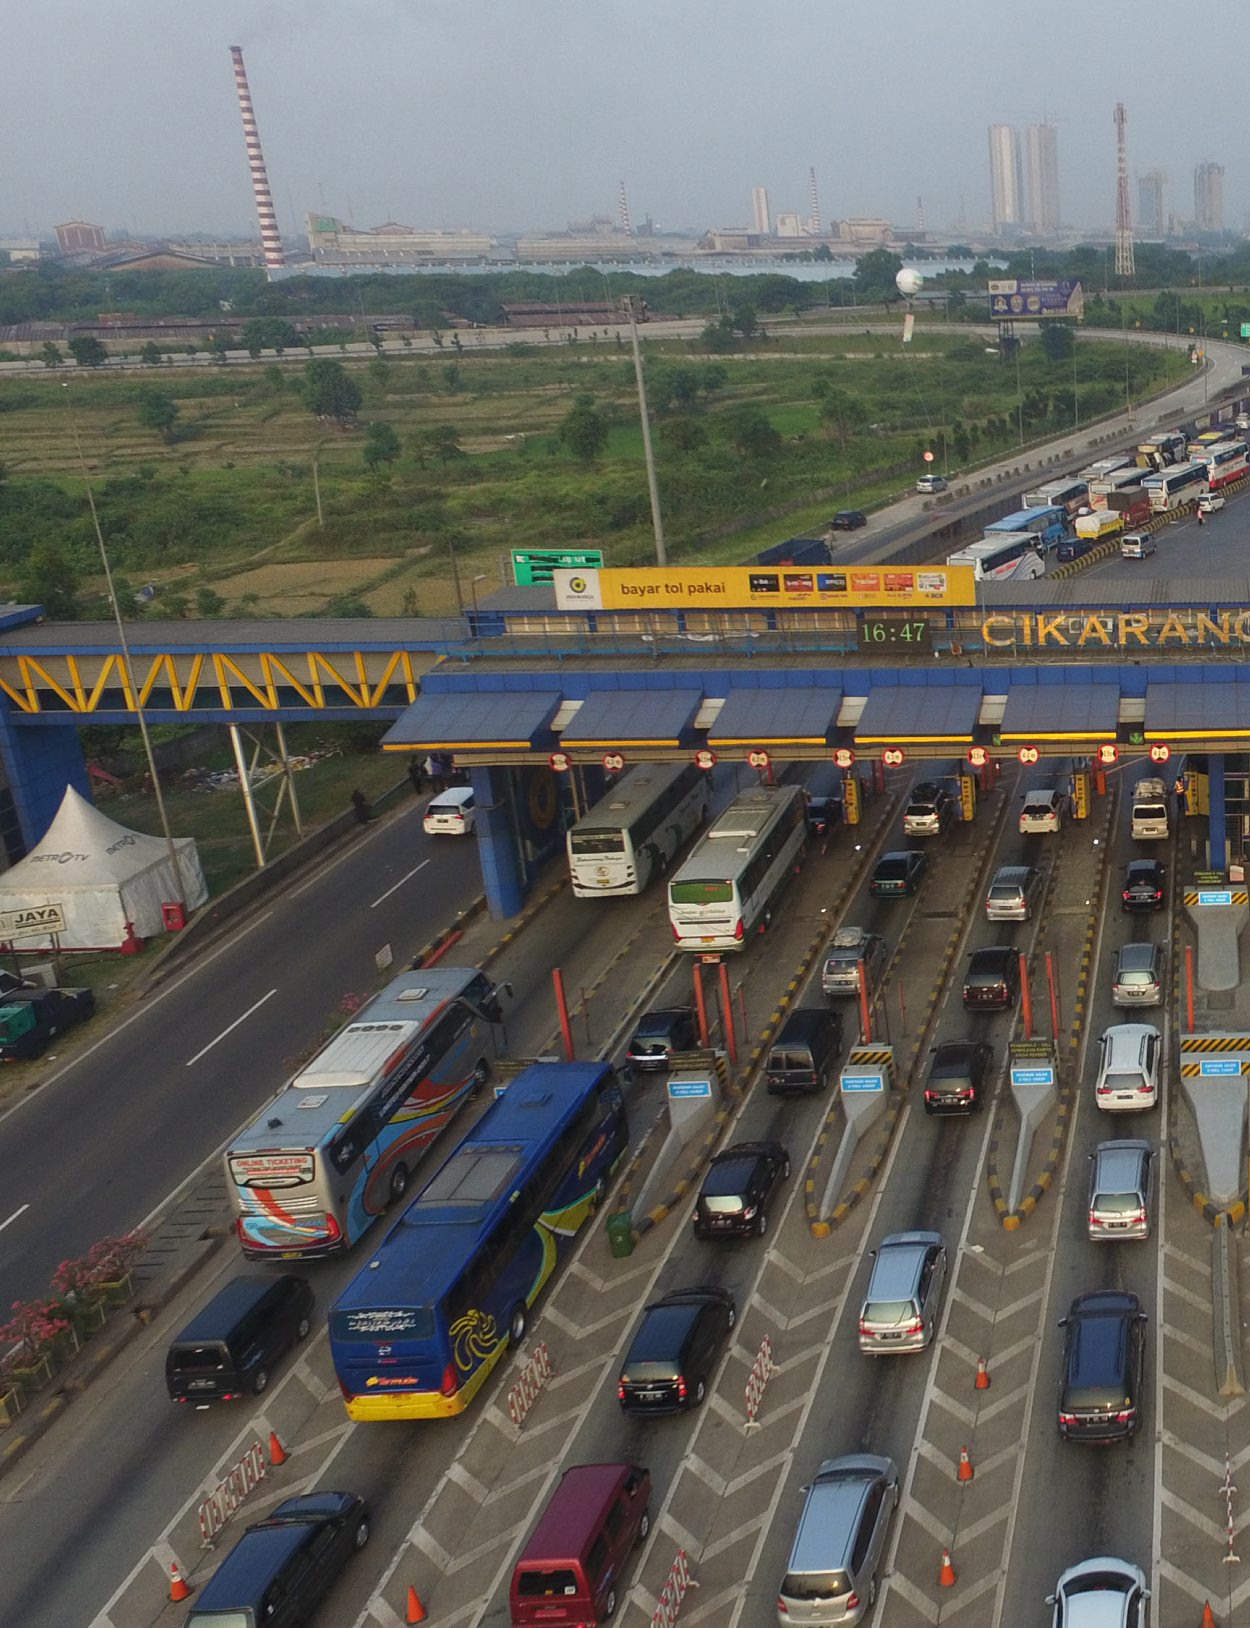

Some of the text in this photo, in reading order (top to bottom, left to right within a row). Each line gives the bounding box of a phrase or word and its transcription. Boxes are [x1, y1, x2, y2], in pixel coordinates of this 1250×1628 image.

[621, 582, 725, 597] bayar tol pakai
[862, 623, 924, 642] 16:47
[14, 908, 59, 924] JAYA
[237, 1158, 307, 1168] ONLINE TICKETING
